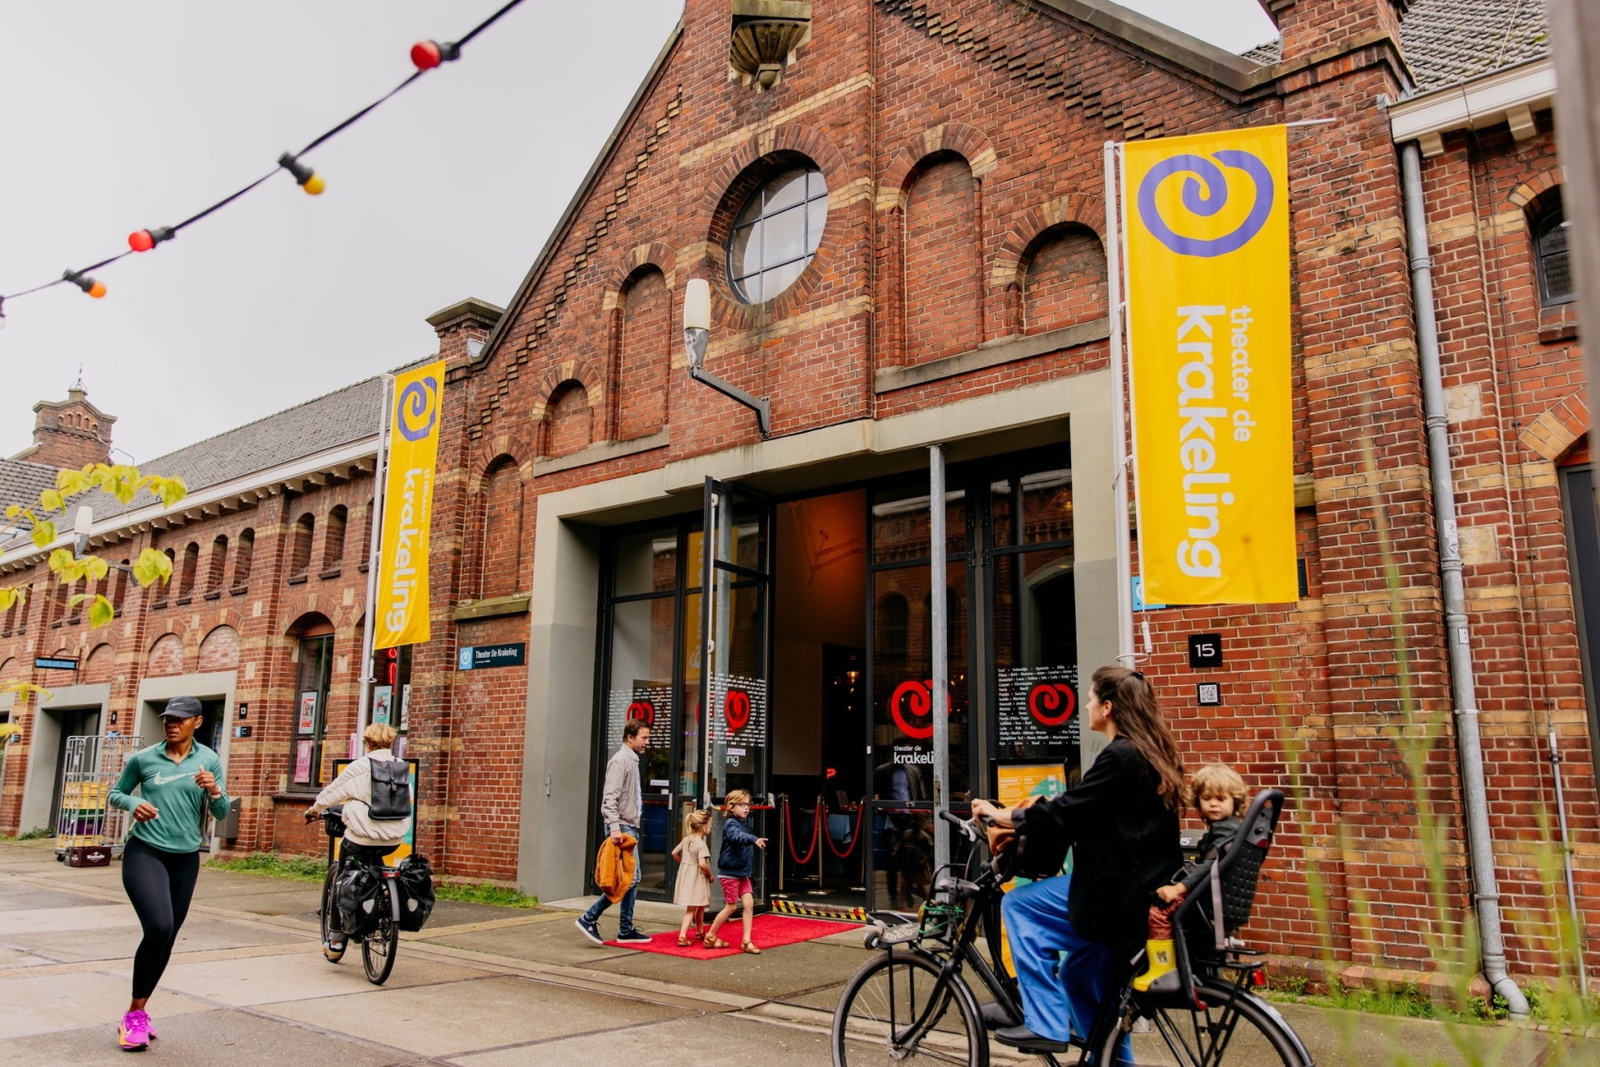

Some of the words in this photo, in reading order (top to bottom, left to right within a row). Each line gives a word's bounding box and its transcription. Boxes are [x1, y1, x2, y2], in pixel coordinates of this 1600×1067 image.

[1230, 305, 1253, 403] theater
[1176, 305, 1234, 578] krakeling
[1233, 409, 1257, 443] de
[386, 469, 422, 632] krakeling
[475, 650, 491, 659] Theater
[491, 649, 498, 657] De
[498, 647, 518, 657] Krakeling
[1195, 643, 1216, 657] 15
[893, 751, 934, 764] krakeli
